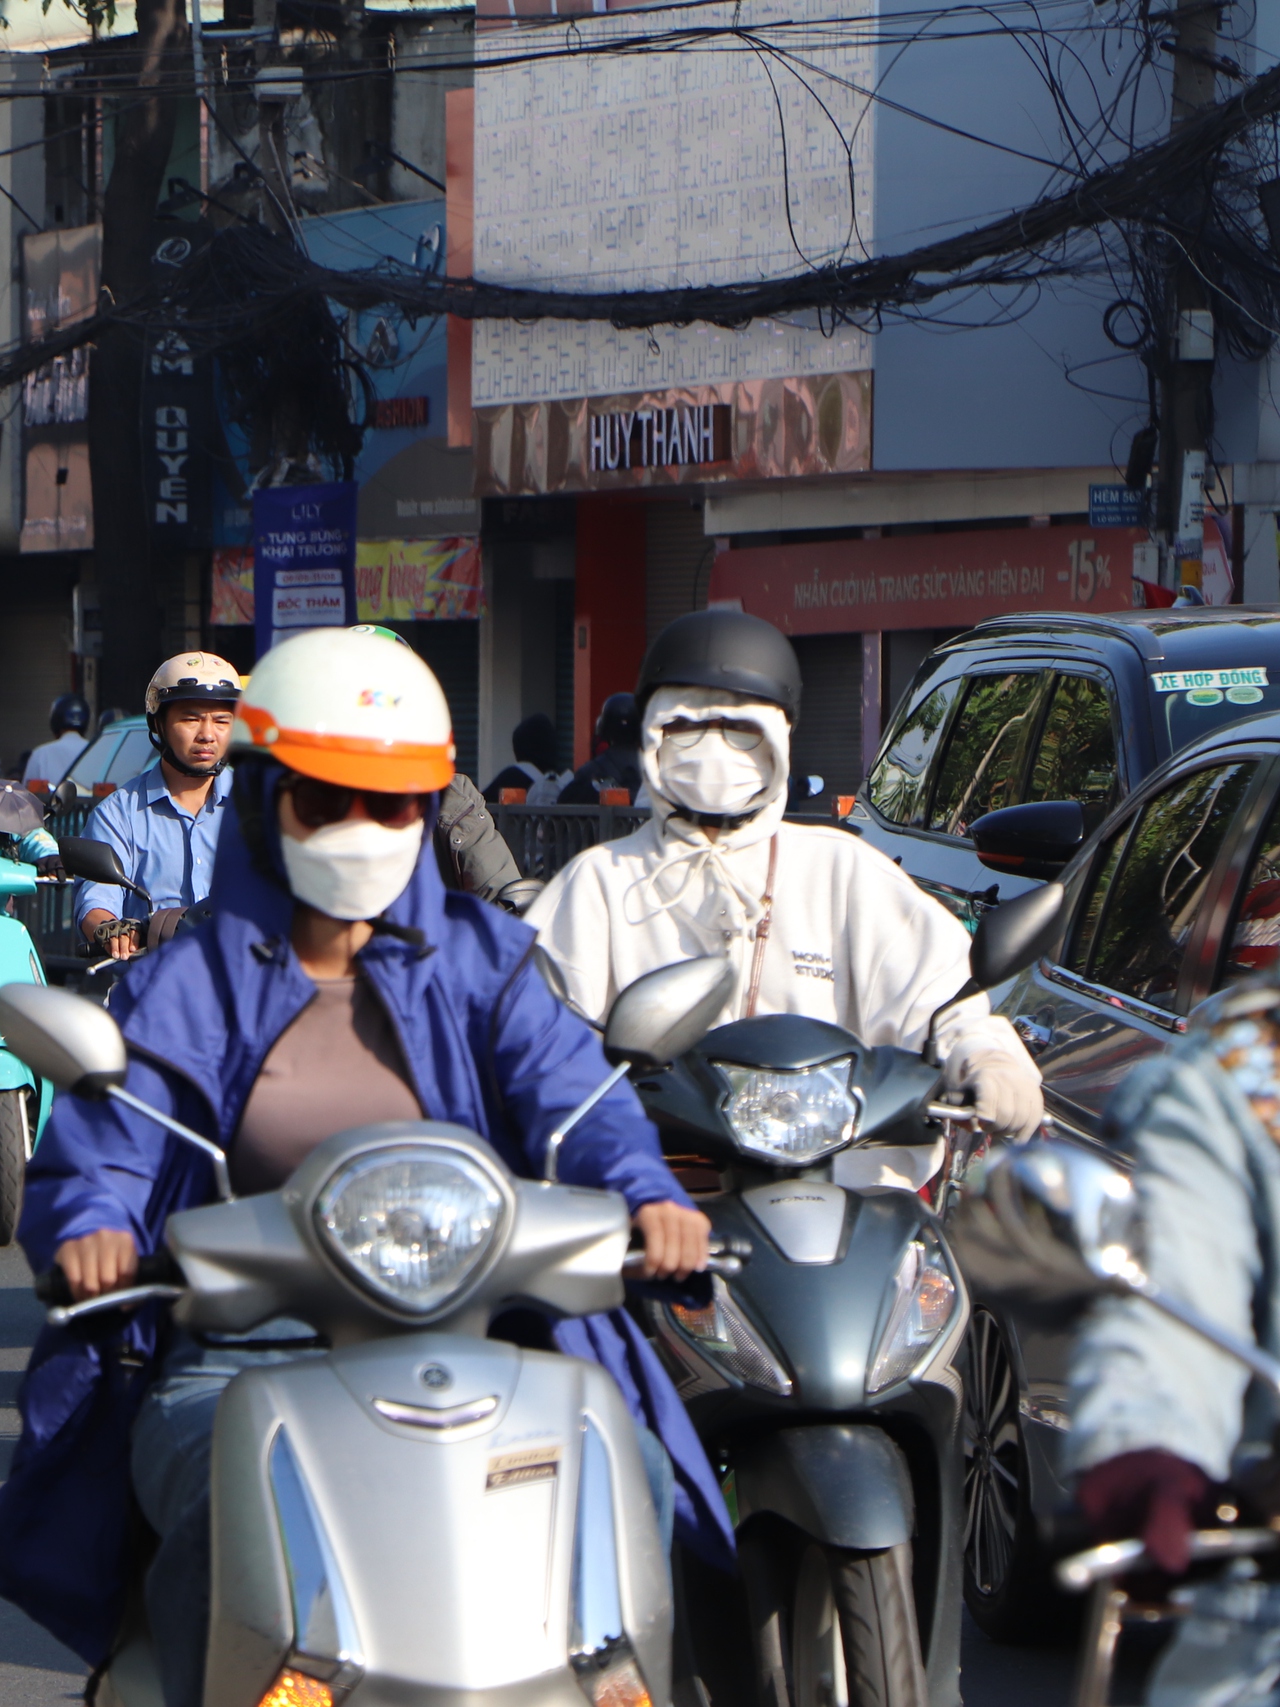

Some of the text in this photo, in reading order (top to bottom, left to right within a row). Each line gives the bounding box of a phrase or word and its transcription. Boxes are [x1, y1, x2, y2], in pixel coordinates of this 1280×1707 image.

[591, 405, 715, 473] HUY THANH
[291, 503, 322, 520] LILY
[1057, 539, 1112, 602] -15%
[879, 573, 920, 603] TRANG
[949, 564, 985, 598] VÀNG
[1159, 675, 1179, 689] XE
[770, 1195, 826, 1204] HONDA
[491, 1464, 555, 1485] Edition
